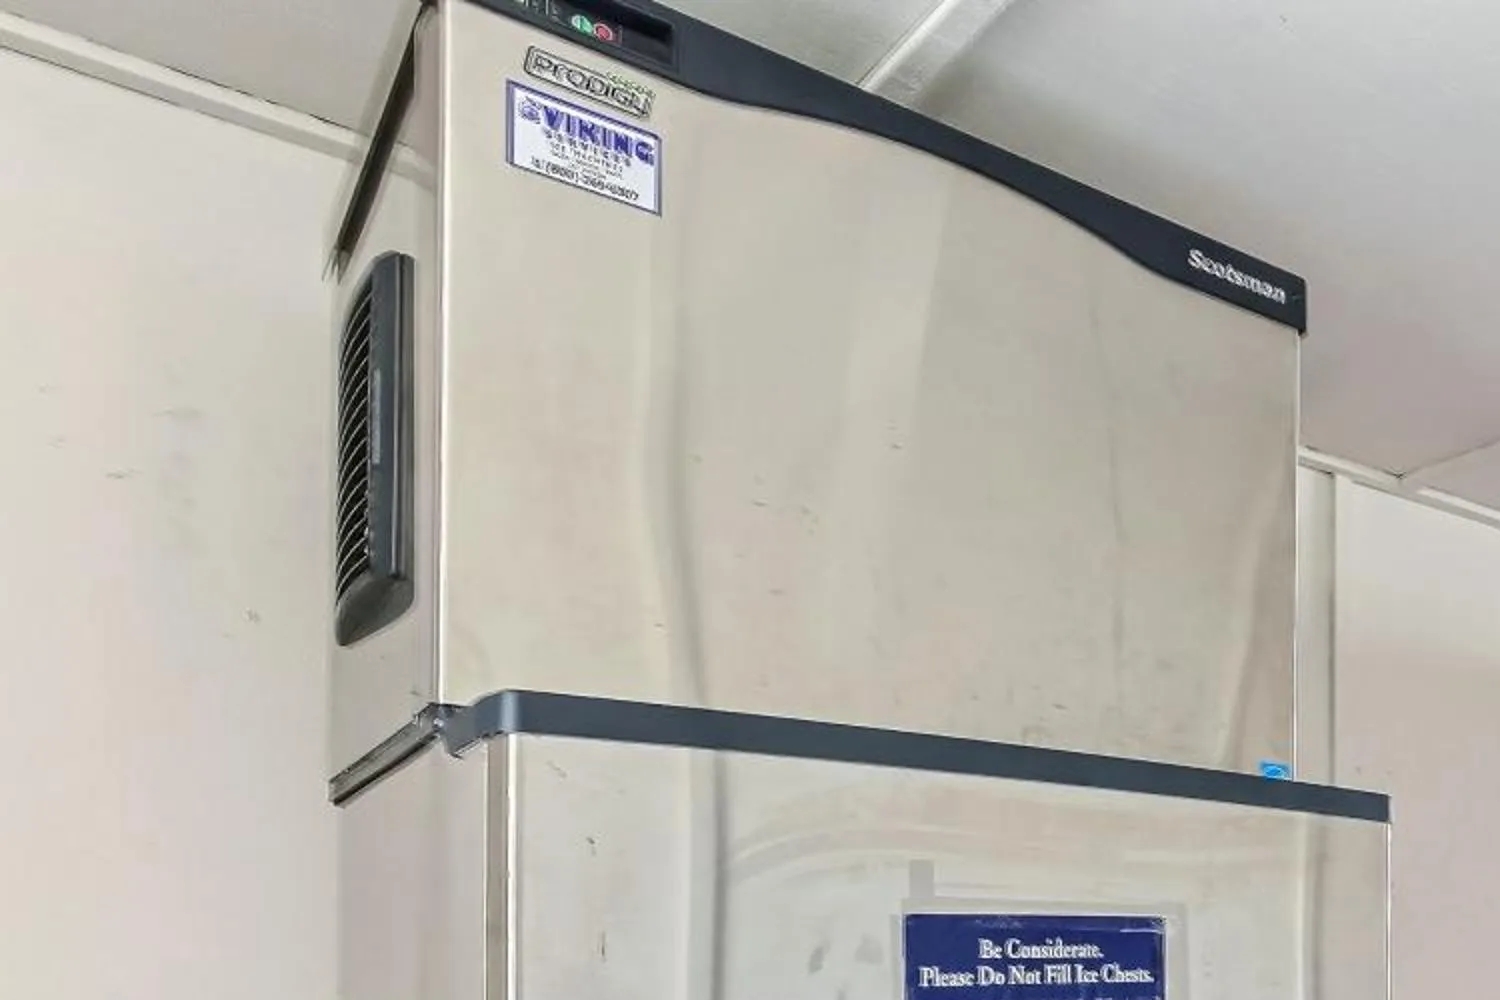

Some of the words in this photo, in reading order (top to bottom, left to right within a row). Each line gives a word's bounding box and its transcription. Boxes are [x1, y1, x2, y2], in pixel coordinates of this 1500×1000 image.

[543, 106, 654, 165] VIKING
[1187, 248, 1287, 305] Scotsman
[978, 937, 1002, 959] Be
[1004, 936, 1105, 960] Considerate.
[918, 966, 975, 988] Please
[976, 965, 1005, 986] Do
[1008, 965, 1041, 986] Not
[1045, 964, 1073, 985] Fill
[1075, 964, 1099, 984] Ice
